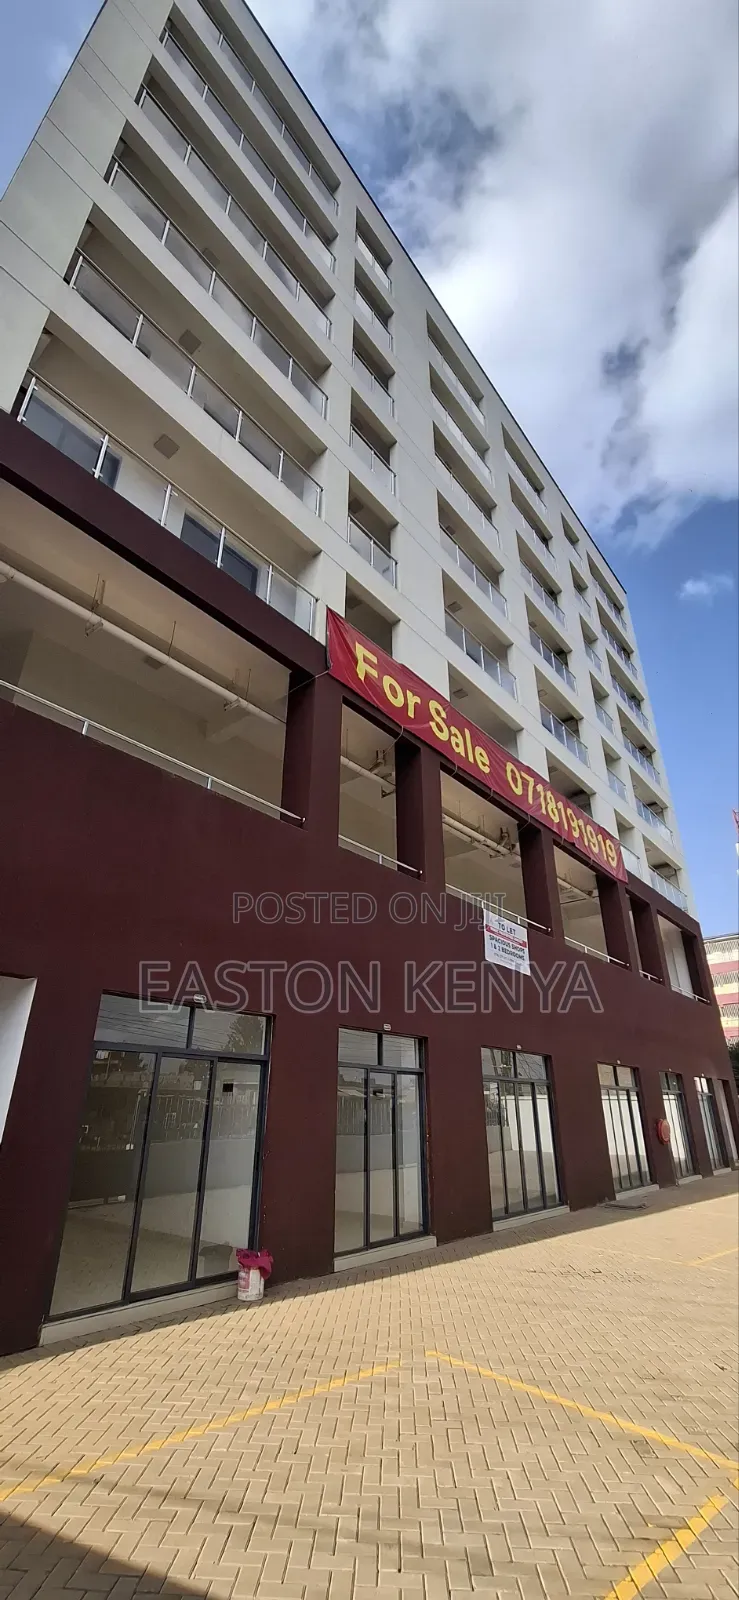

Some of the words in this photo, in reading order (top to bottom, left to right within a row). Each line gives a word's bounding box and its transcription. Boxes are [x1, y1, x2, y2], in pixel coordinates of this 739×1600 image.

[355, 641, 421, 719] For
[429, 698, 490, 774] Sale
[505, 761, 619, 868] 0718191919
[498, 922, 505, 930] TO
[506, 927, 516, 935] LET
[489, 935, 511, 948] SPACIOUS
[512, 944, 525, 954] SHOPS
